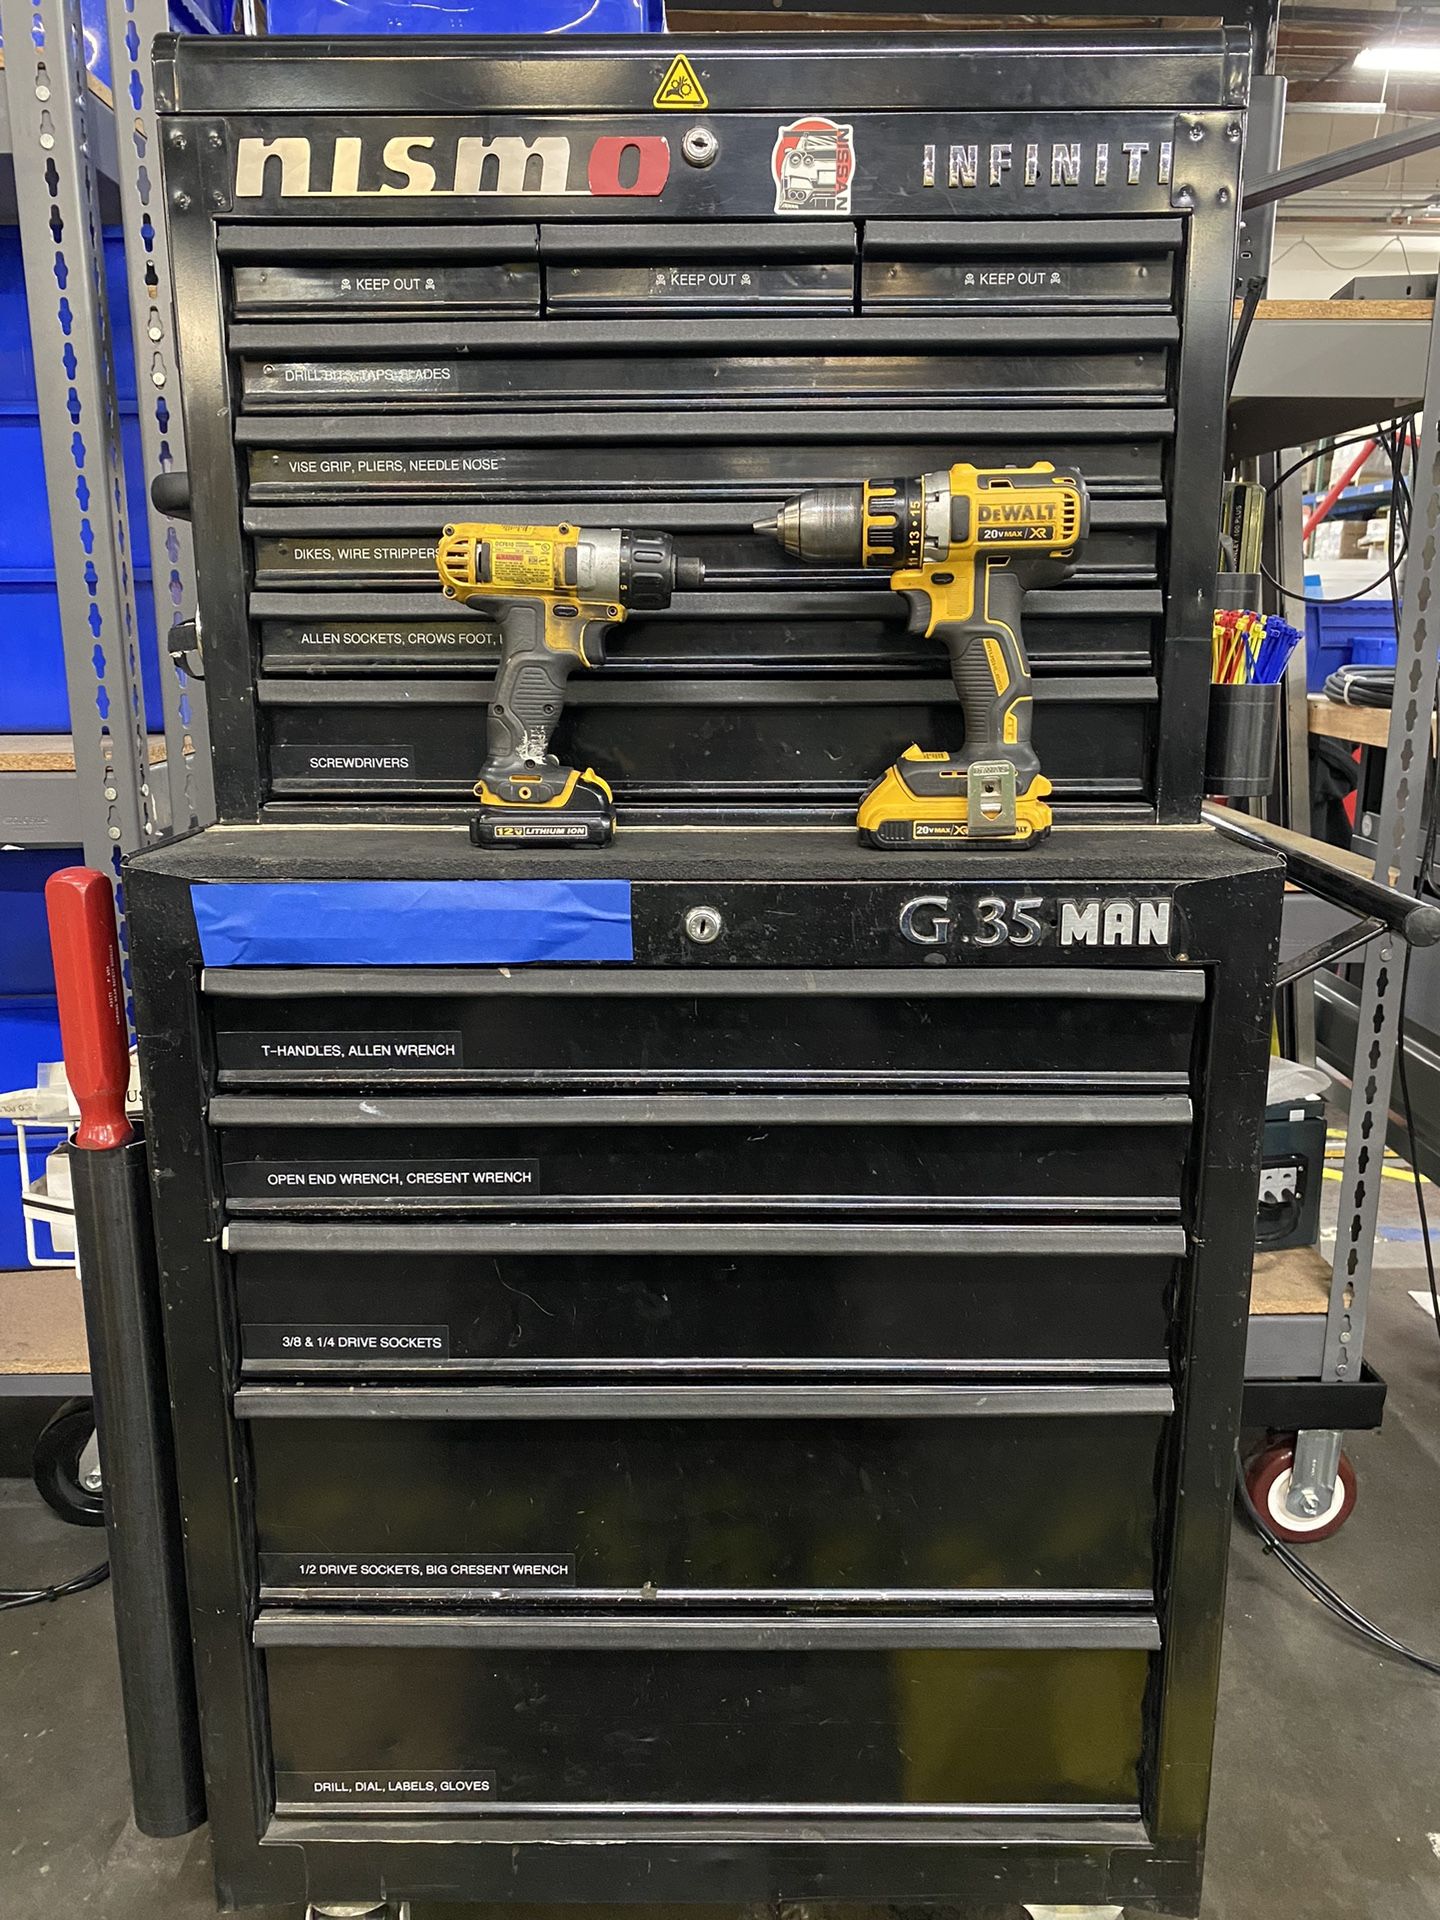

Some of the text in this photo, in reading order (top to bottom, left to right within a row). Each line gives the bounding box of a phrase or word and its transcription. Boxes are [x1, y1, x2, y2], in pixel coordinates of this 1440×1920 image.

[235, 135, 670, 197] nismo
[835, 128, 850, 211] NISSAN
[923, 141, 1173, 188] INFINITI
[355, 278, 421, 291] KEEP OUT
[671, 273, 736, 286] KEEP OUT
[979, 272, 1046, 285] KEEP OUT
[285, 369, 321, 382] DRILL
[288, 458, 499, 474] VISE GRIP, PLIERS, NEEDLE NOSE
[910, 500, 921, 517] 15
[909, 530, 921, 546] 13
[1029, 528, 1047, 539] XR
[294, 548, 335, 561] DIKES,
[339, 548, 370, 560] WIRE
[301, 633, 340, 644] ALLEN
[343, 632, 405, 646] SOCKETS,
[407, 632, 456, 644] CROWS
[458, 632, 496, 646] FOOT,
[309, 757, 409, 769] SCREWDRIVERS
[526, 827, 565, 835] LITHIUM
[567, 827, 585, 835] ION
[1057, 898, 1173, 947] MAN
[261, 1044, 456, 1058] T-HANDLES, ALLEN WRENCH
[267, 1171, 532, 1187] OPEN END WRENCH, CRESENT WRENCH
[282, 1336, 442, 1349] 3/8 & 1/4 DRIVE SOCKETS
[299, 1563, 569, 1577] 1/2 DRIVE SOCKETS, BIG CRESENT WRENCH
[314, 1781, 490, 1793] DRILL, DIAL, LABELS, GLOVES
